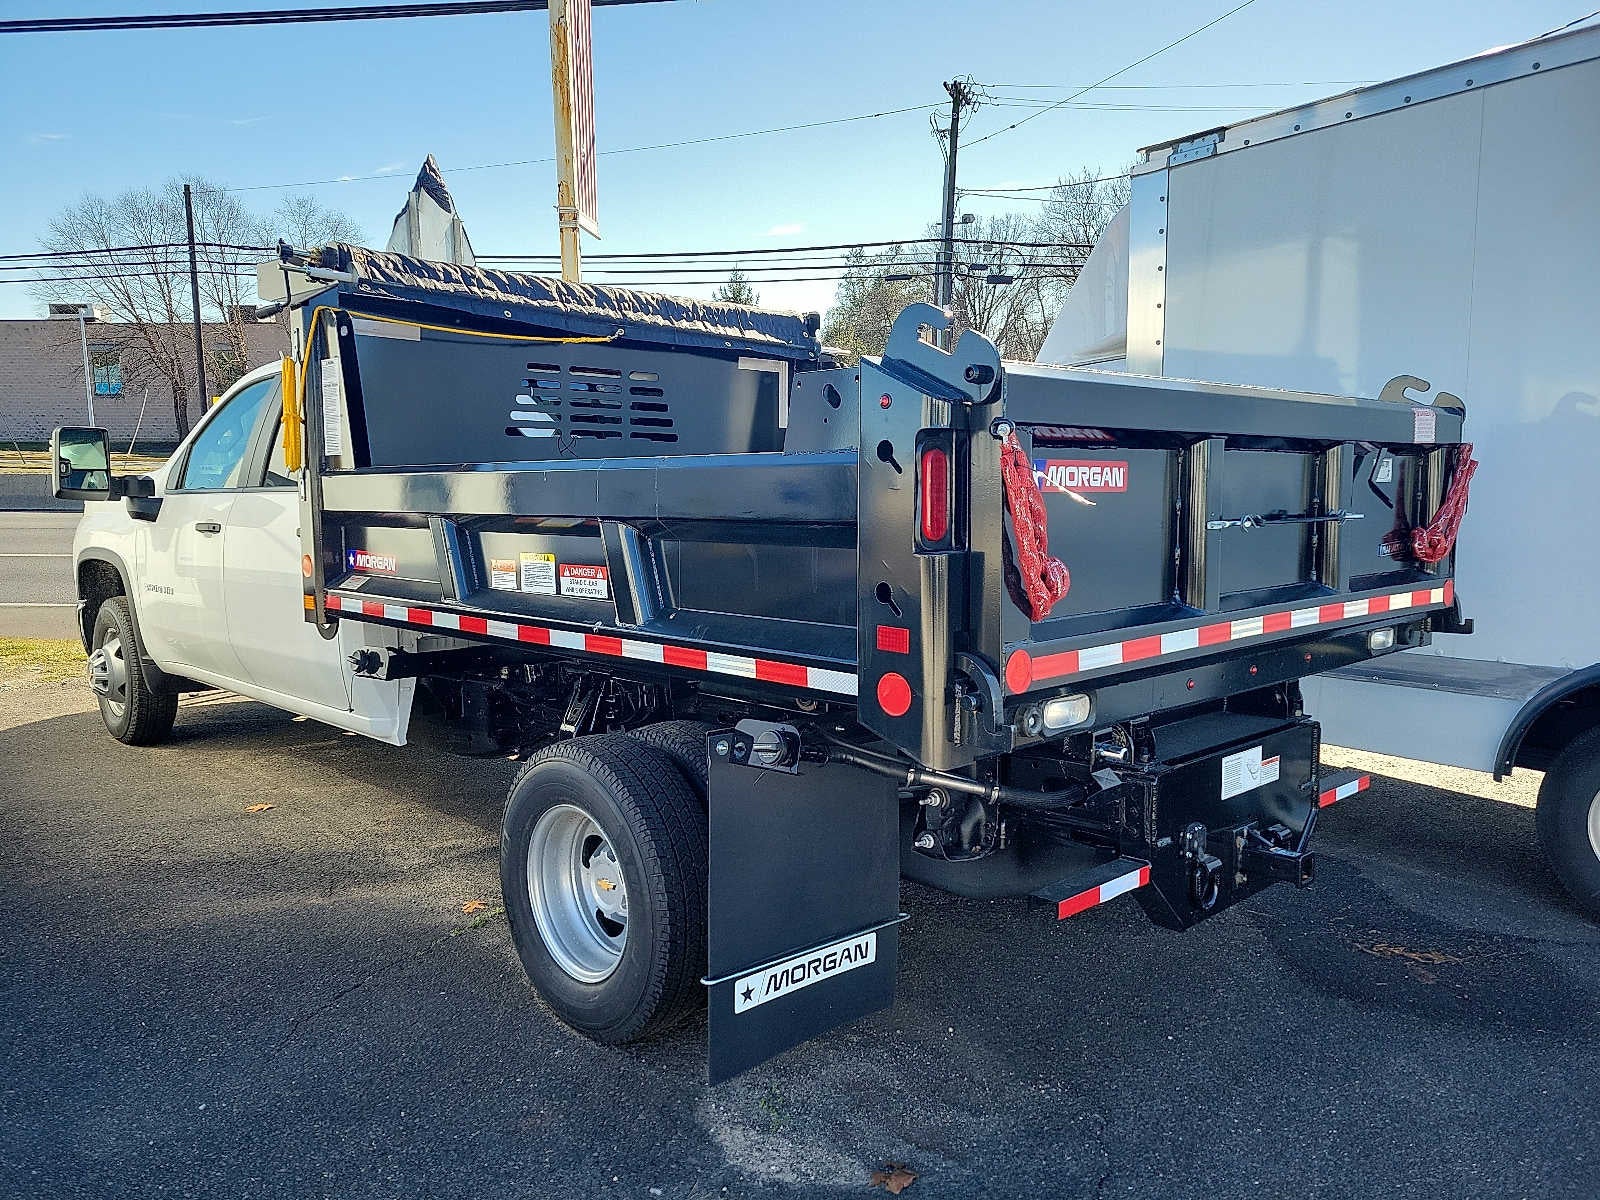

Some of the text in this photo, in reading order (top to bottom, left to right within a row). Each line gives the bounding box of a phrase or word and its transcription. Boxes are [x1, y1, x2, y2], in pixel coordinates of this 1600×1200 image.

[1046, 465, 1124, 487] MORGAN
[356, 554, 396, 571] MORGAN
[570, 567, 597, 577] DANGER
[764, 941, 869, 996] MORGAN
